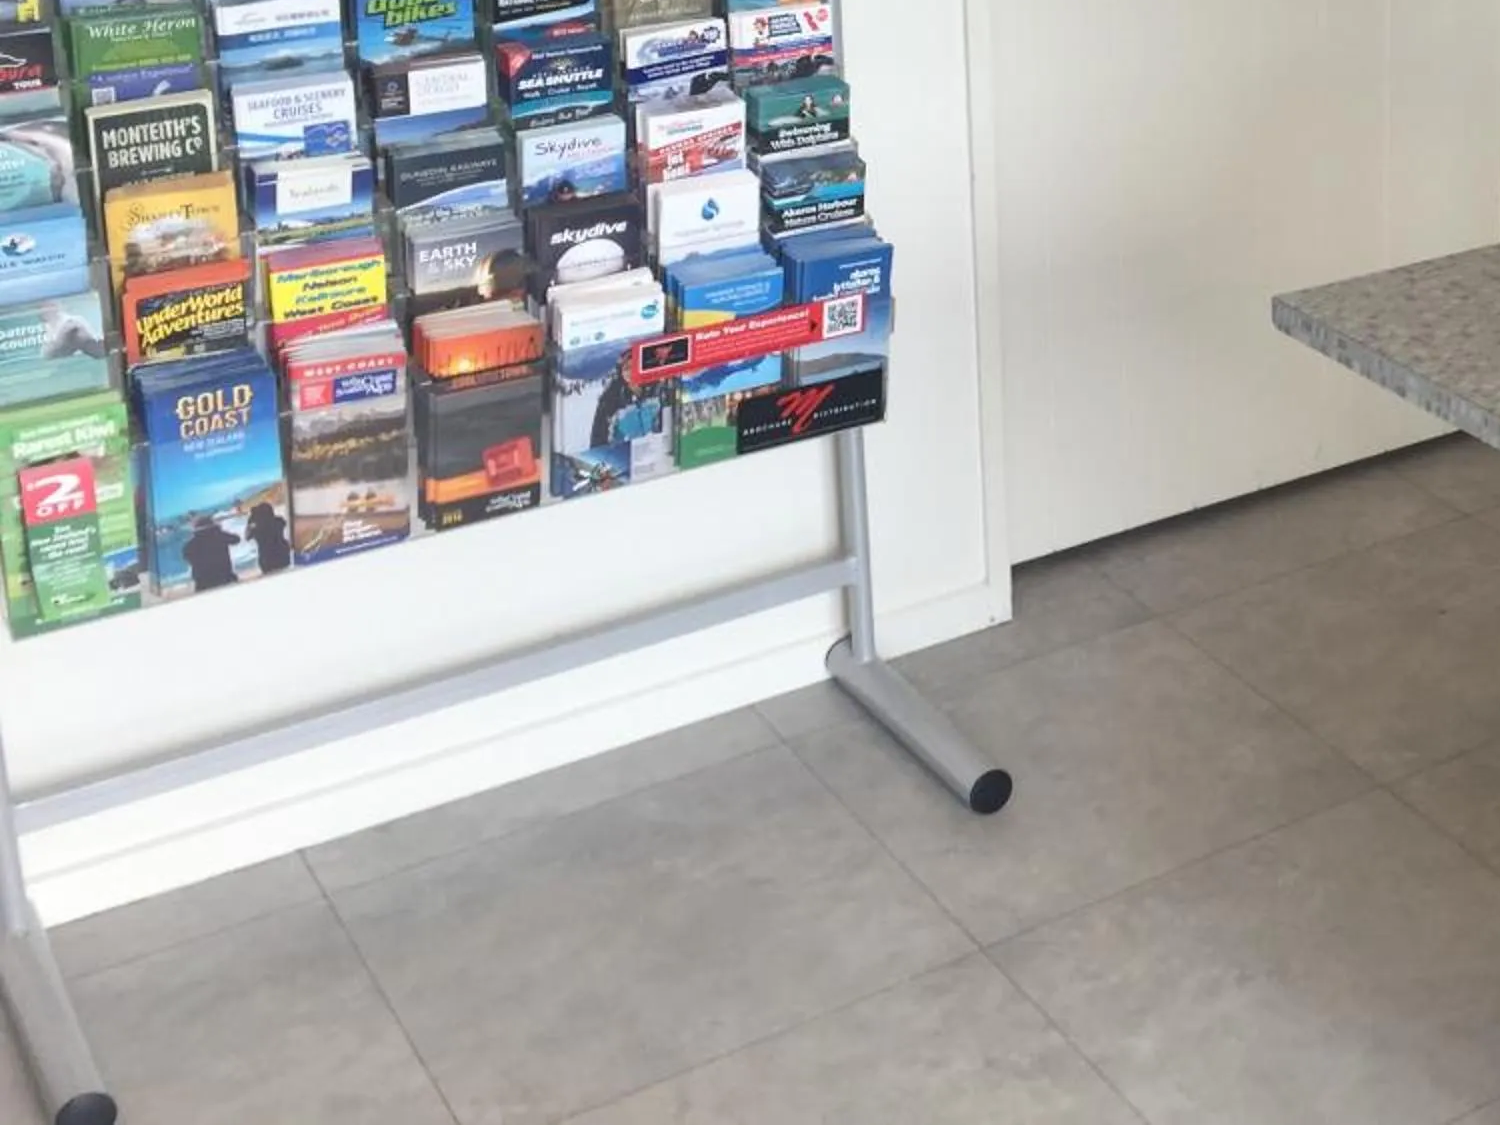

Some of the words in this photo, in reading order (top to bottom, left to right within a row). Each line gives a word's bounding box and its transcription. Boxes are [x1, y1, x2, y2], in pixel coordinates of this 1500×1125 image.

[88, 24, 138, 40] White
[142, 16, 197, 32] Heron
[518, 78, 544, 90] SEA
[546, 68, 603, 86] SHUTTLE
[272, 104, 322, 120] CRUISES
[102, 115, 203, 150] MONTEITH'S
[107, 137, 181, 169] BREWING
[535, 136, 601, 159] Skydive
[551, 221, 627, 245] skydive
[420, 243, 477, 262] EARTH
[443, 255, 477, 270] SKY
[142, 303, 243, 348] Adventures
[177, 385, 253, 420] GOLD
[180, 410, 252, 439] COAST
[36, 498, 84, 517] OFF
